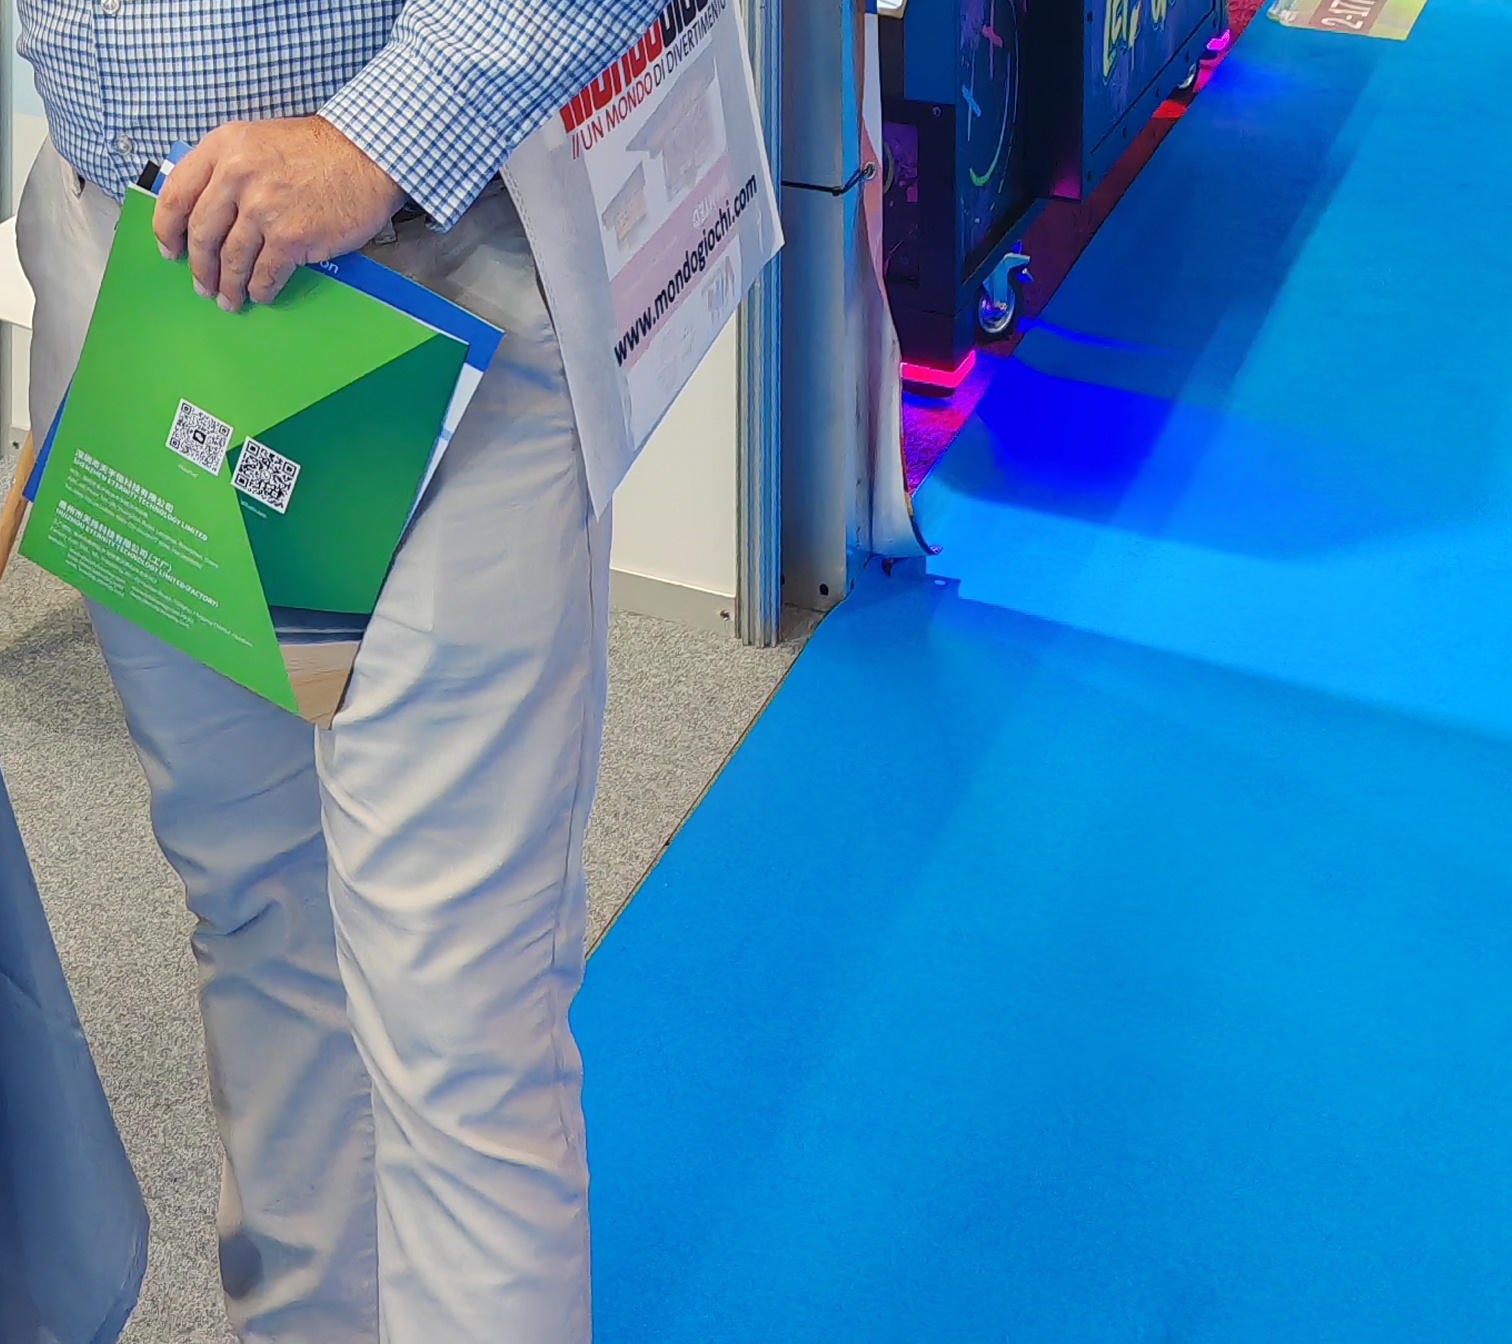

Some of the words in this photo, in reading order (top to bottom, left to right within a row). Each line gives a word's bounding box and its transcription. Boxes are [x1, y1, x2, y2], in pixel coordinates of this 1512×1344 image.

[606, 72, 652, 132] MONDO
[653, 59, 665, 87] DI
[615, 174, 757, 368] www.mondogiochi.com
